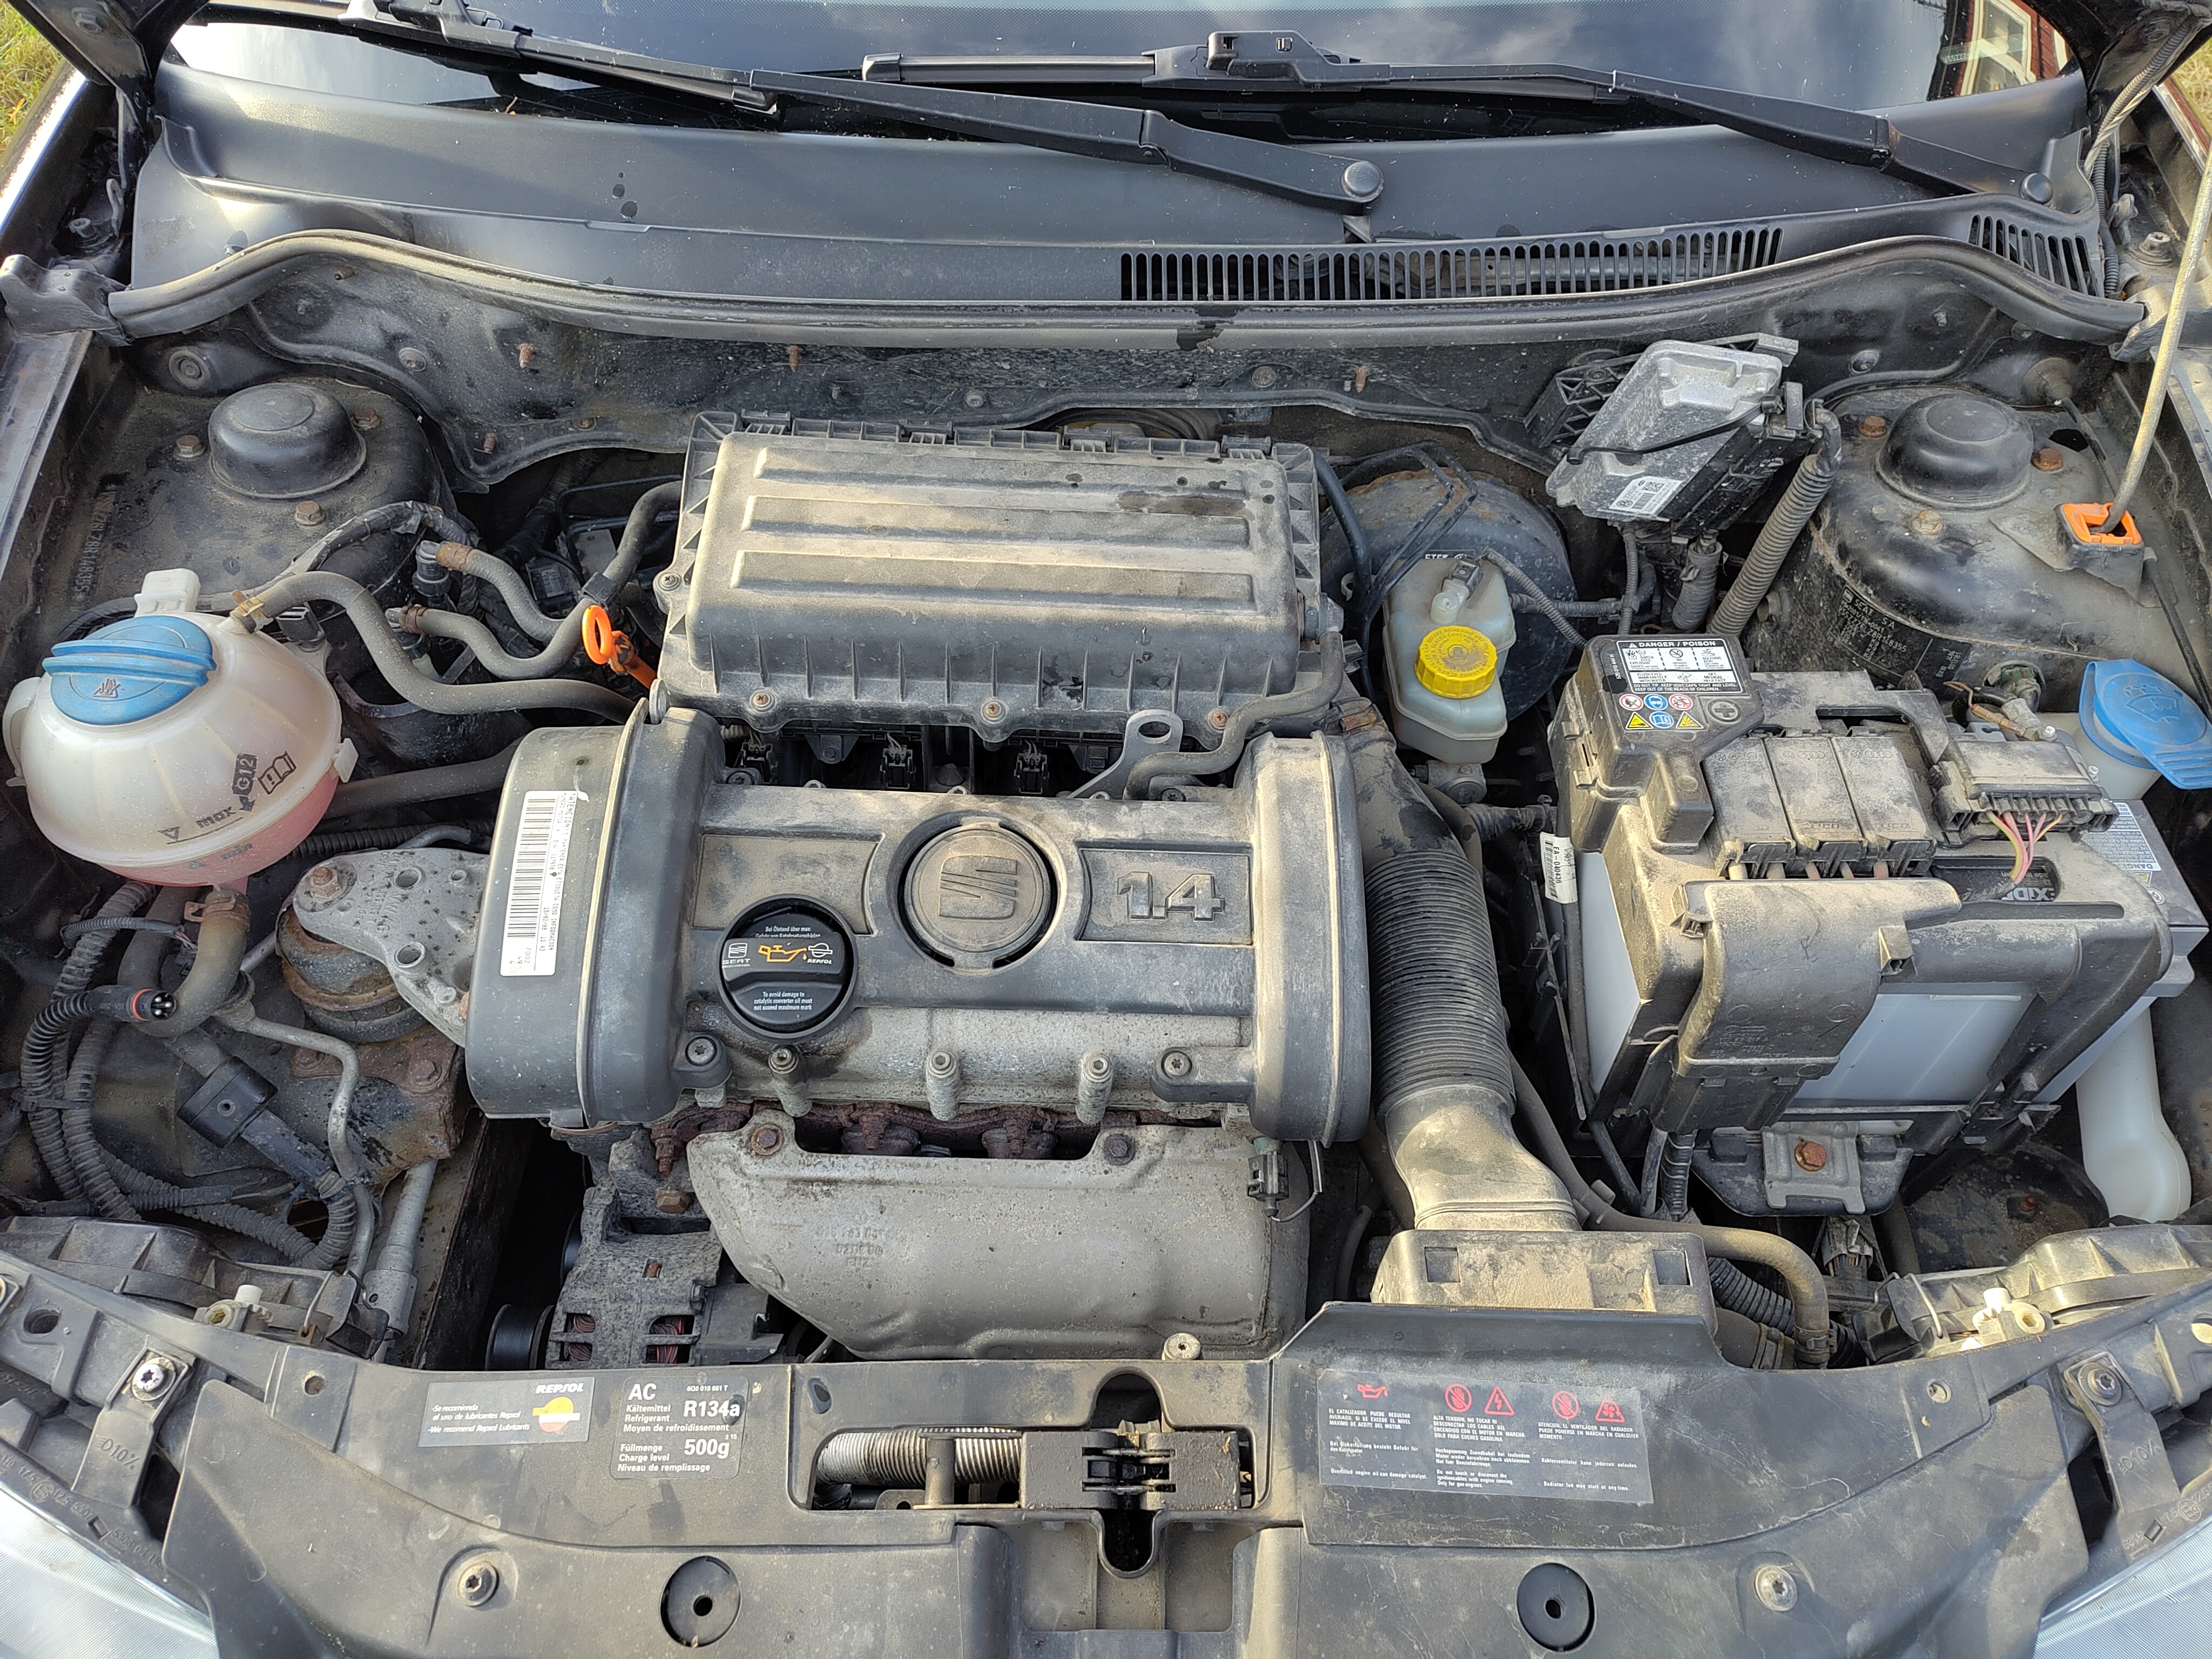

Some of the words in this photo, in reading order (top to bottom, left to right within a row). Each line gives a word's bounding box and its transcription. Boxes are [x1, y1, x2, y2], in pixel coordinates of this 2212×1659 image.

[1854, 599, 1873, 616] SEAT
[237, 758, 254, 790] G12
[195, 806, 237, 829] max
[1117, 871, 1225, 922] 1.4
[517, 956, 523, 964] 49
[536, 1382, 584, 1394] REPSOL
[628, 1383, 657, 1400] AC
[626, 1404, 671, 1412] Kältemittel
[683, 1400, 740, 1417] R134a
[465, 1412, 498, 1420] lubricantes
[500, 1411, 521, 1420] Repsol
[624, 1414, 670, 1424] Refrigerant
[476, 1424, 497, 1433] Repsol
[623, 1424, 651, 1433] Moyen
[621, 1444, 663, 1453] Füllmenge
[684, 1438, 730, 1459] 500g
[619, 1453, 648, 1462] Charge
[650, 1453, 670, 1461] level
[617, 1464, 646, 1472] Niveau
[660, 1462, 711, 1472] remplissage
